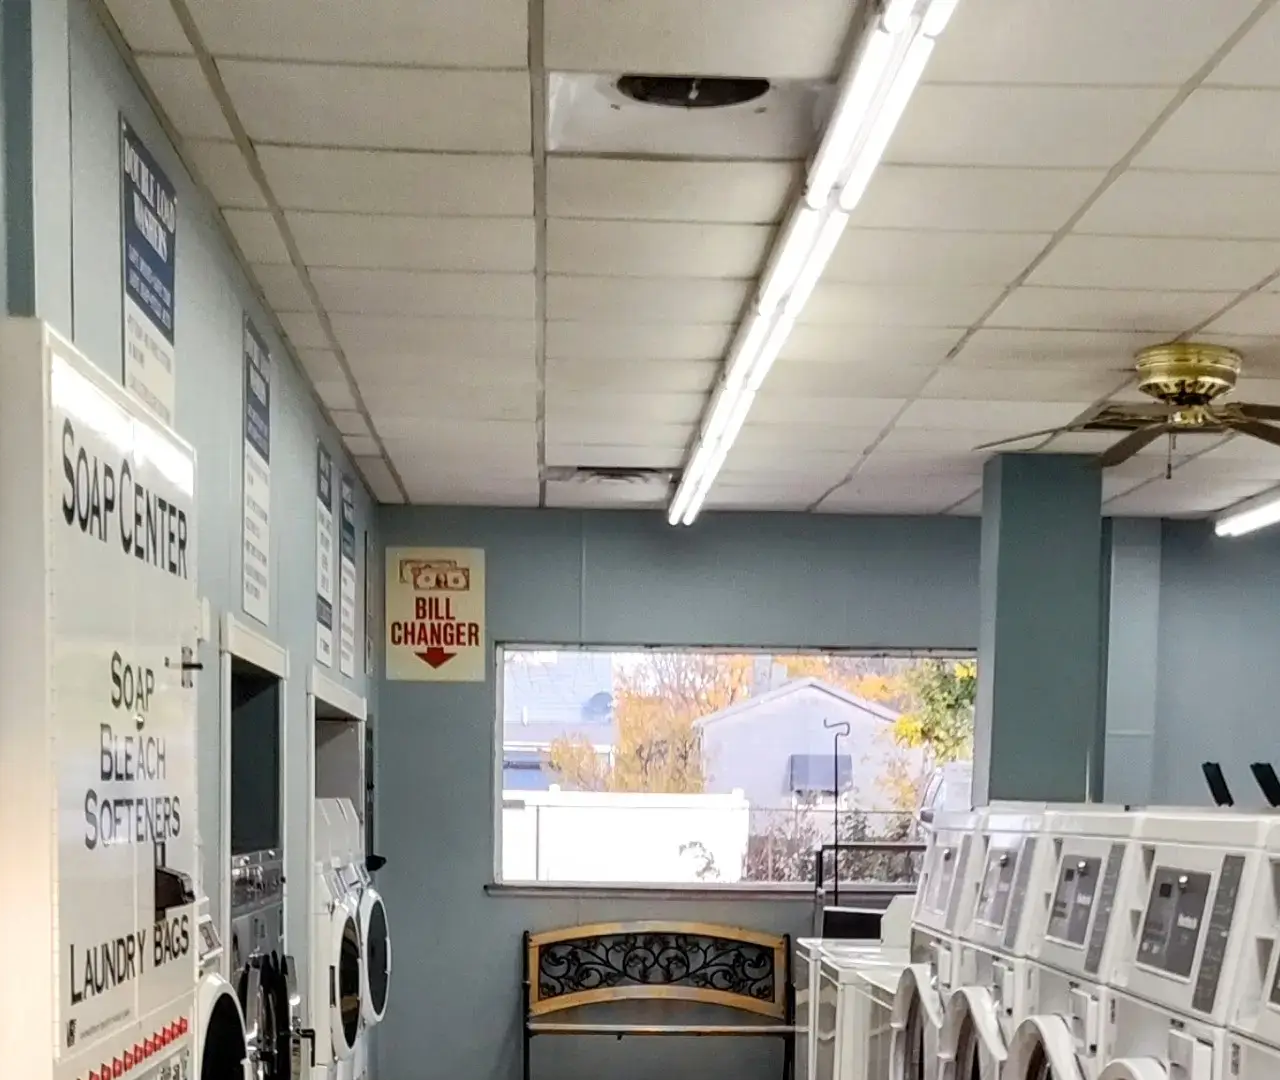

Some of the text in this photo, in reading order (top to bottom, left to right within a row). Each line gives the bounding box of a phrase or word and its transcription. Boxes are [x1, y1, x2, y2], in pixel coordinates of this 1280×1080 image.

[62, 417, 115, 543] SOAP
[119, 458, 188, 580] CENTER
[391, 622, 480, 646] CHANGER
[415, 596, 456, 620] BILL
[111, 650, 155, 712] SOAP
[100, 722, 167, 781] BLEACH
[84, 788, 181, 850] SOFTENERS
[70, 914, 190, 1007] LAUNDRY BAGS
